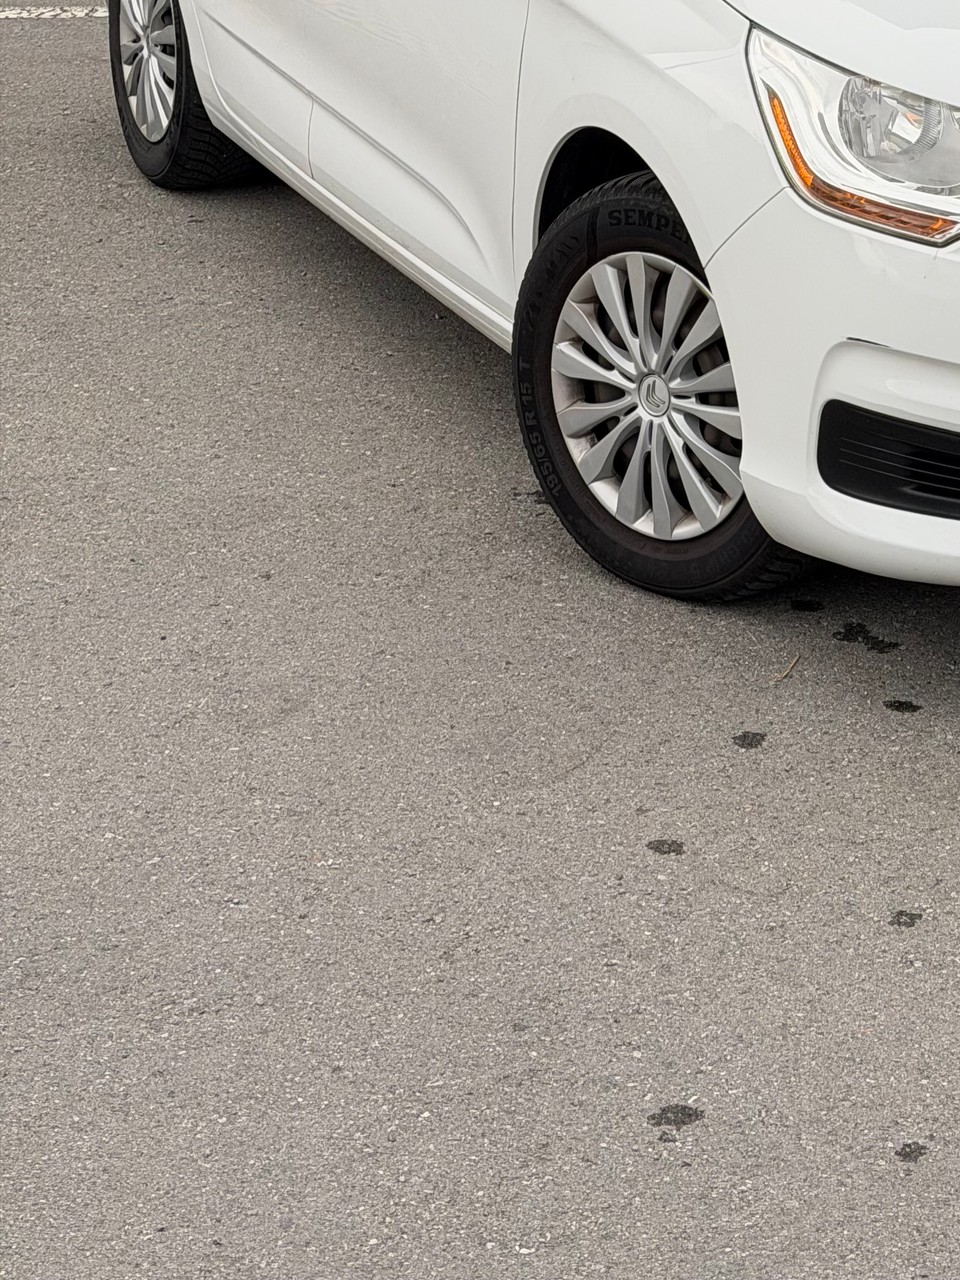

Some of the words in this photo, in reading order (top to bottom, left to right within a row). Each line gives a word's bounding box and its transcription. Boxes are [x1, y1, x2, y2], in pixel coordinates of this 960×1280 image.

[607, 208, 690, 244] SEMPE
[520, 381, 532, 405] 15
[525, 411, 536, 426] R
[528, 431, 561, 497] 195/65
